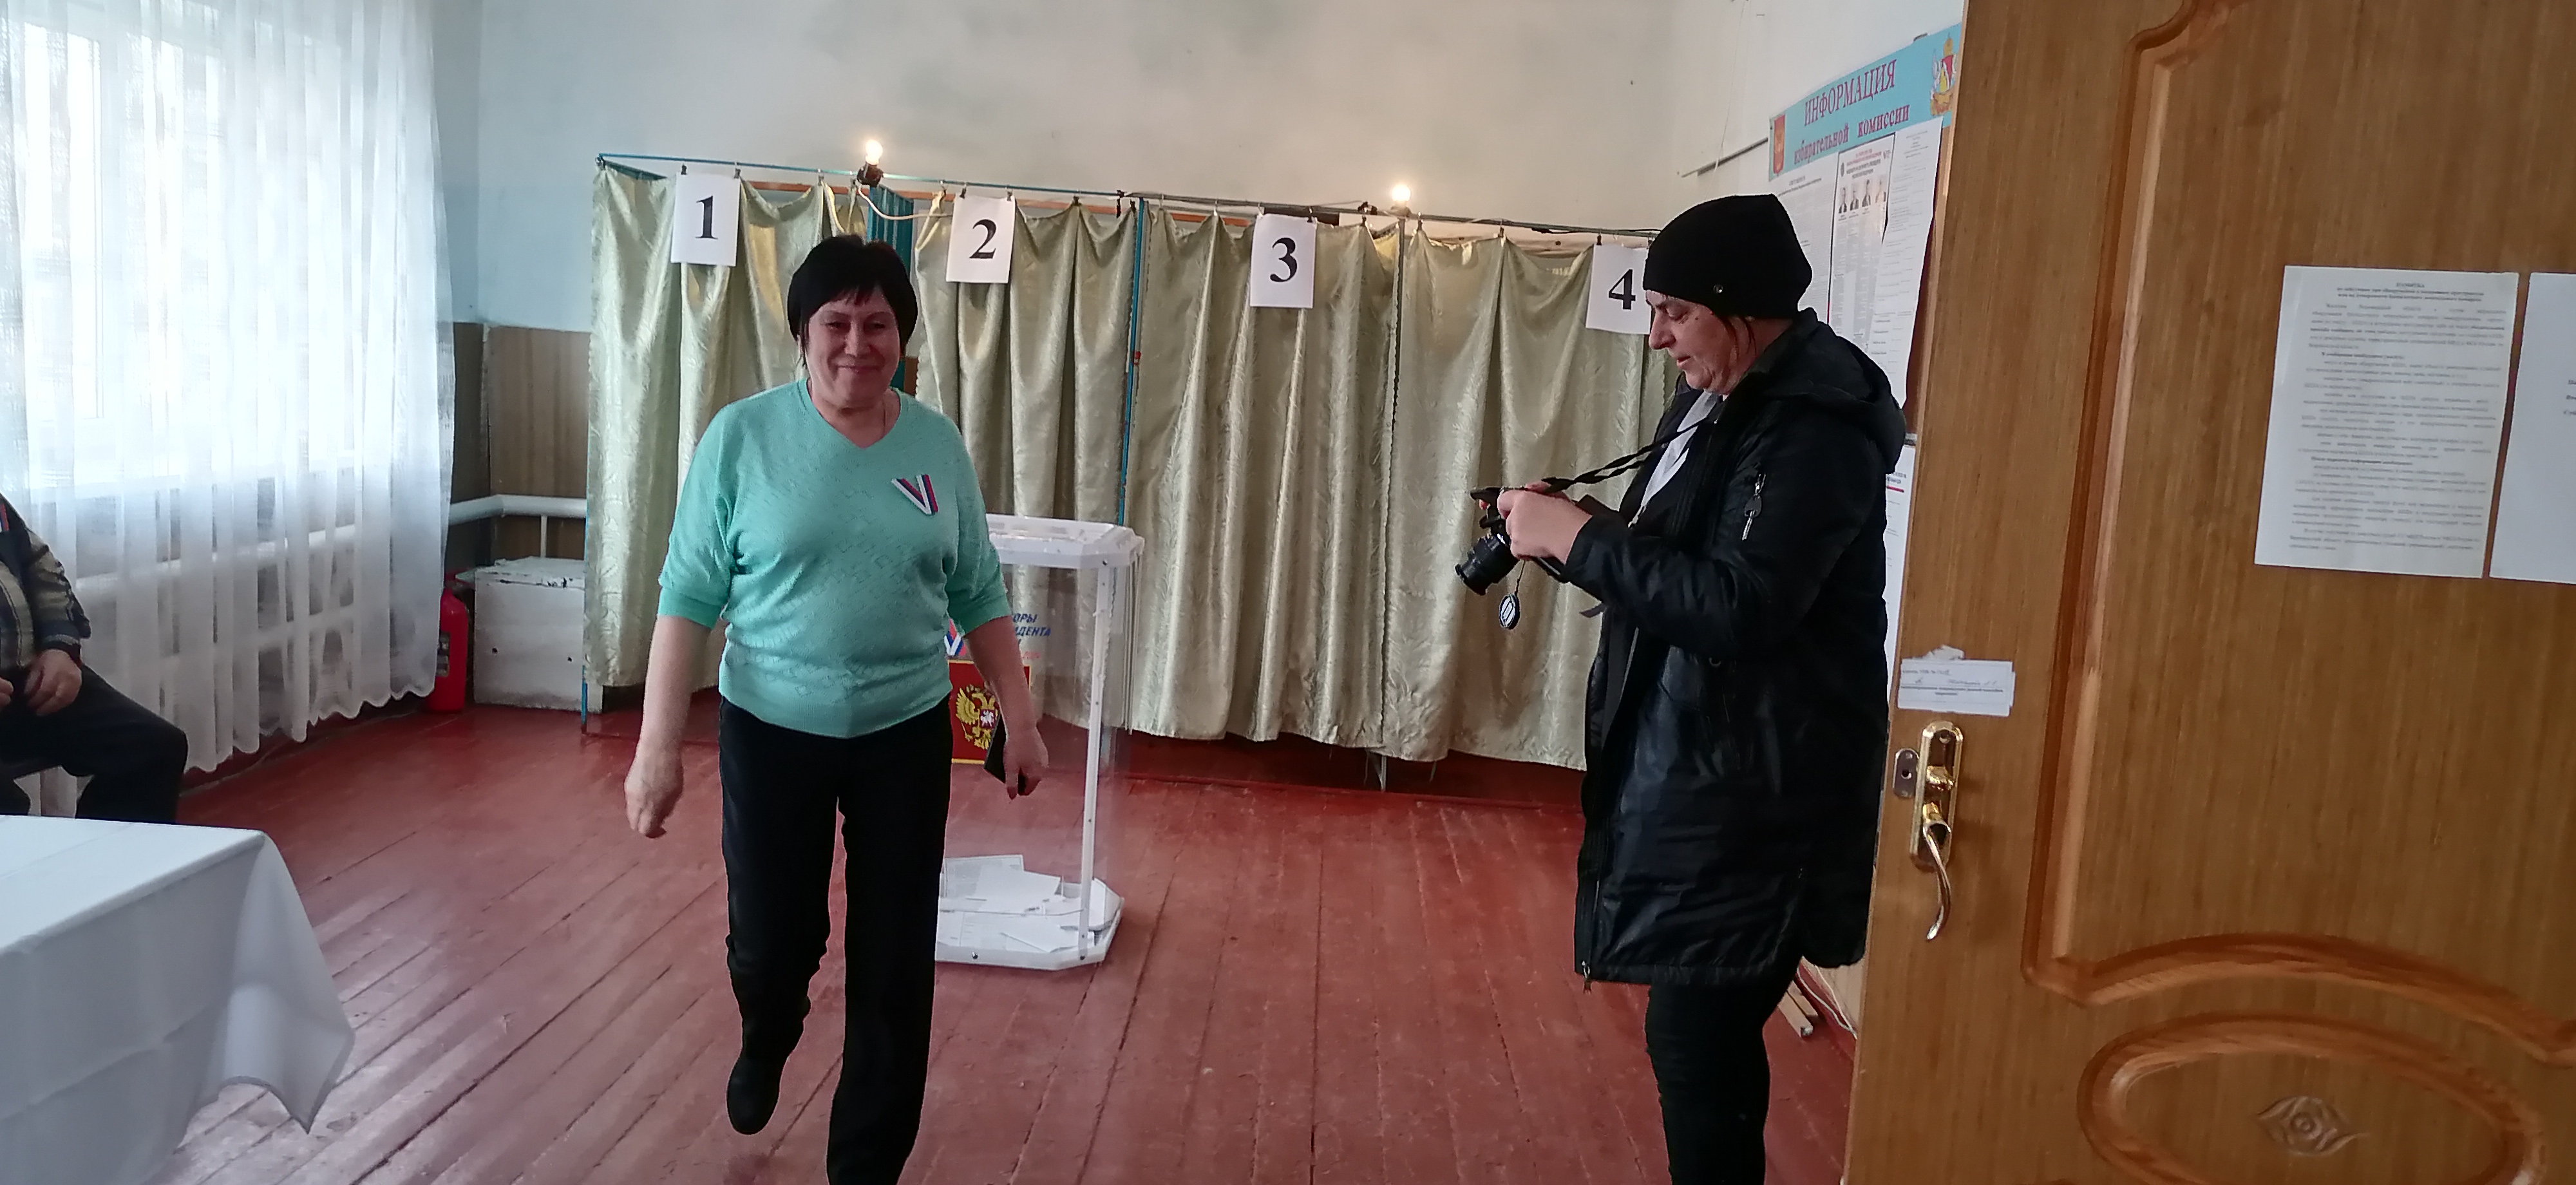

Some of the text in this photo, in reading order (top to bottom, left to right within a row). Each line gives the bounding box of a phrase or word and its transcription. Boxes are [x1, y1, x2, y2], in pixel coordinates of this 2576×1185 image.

[1804, 59, 1897, 126] ИНФОРМАЦИЯ
[1794, 104, 1909, 164] избирательной комиссии
[696, 195, 719, 240] 1
[969, 219, 998, 259] 2
[1269, 237, 1298, 282] 3
[1608, 269, 1636, 310] 4
[1013, 612, 1037, 623] ОРЫ
